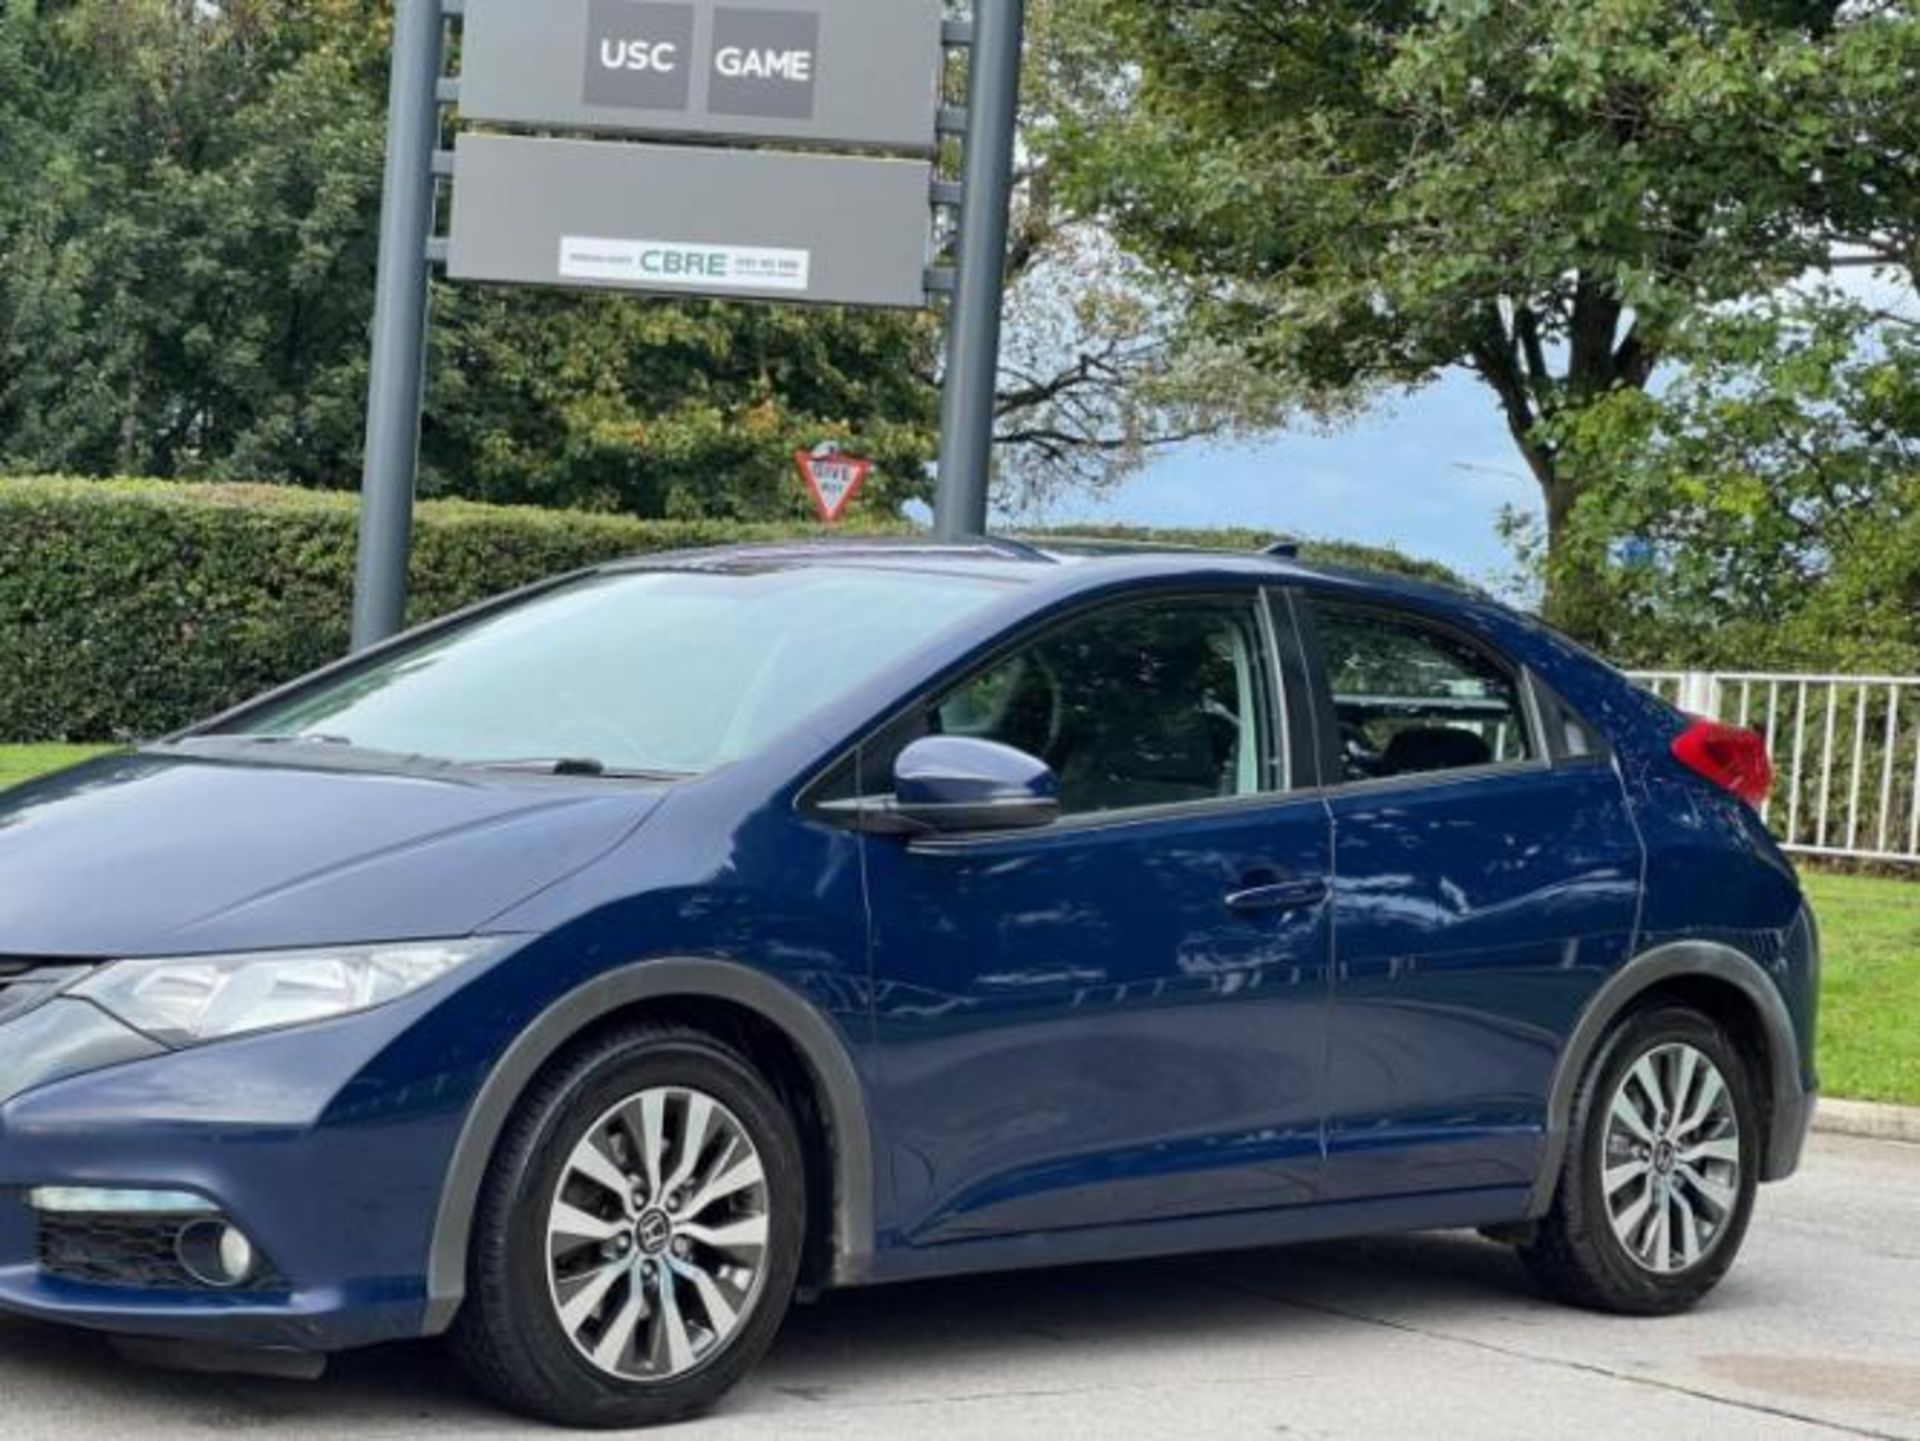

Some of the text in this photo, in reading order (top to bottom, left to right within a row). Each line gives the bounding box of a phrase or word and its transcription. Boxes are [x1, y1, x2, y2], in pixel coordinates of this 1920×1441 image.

[600, 39, 676, 73] USC
[714, 47, 811, 81] GAME
[640, 249, 730, 276] CBRE
